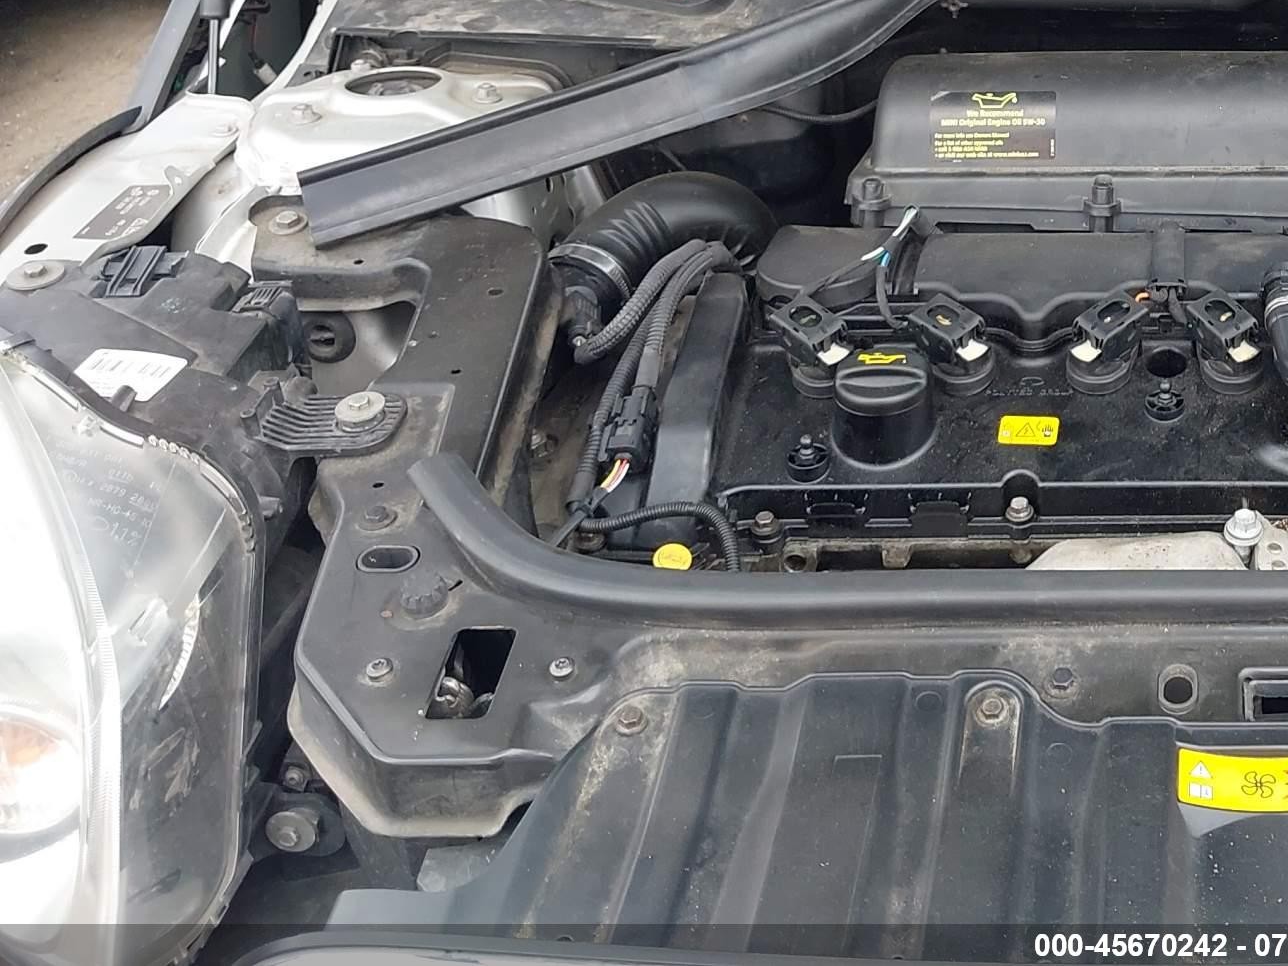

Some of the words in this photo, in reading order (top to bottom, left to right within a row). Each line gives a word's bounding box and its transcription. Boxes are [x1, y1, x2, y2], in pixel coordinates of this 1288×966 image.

[979, 109, 1024, 118] Recommend
[941, 118, 958, 126] MINI
[959, 118, 987, 128] Original
[987, 118, 1011, 128] Engine
[1011, 118, 1022, 126] Oil
[1022, 118, 1046, 126] 5W-30
